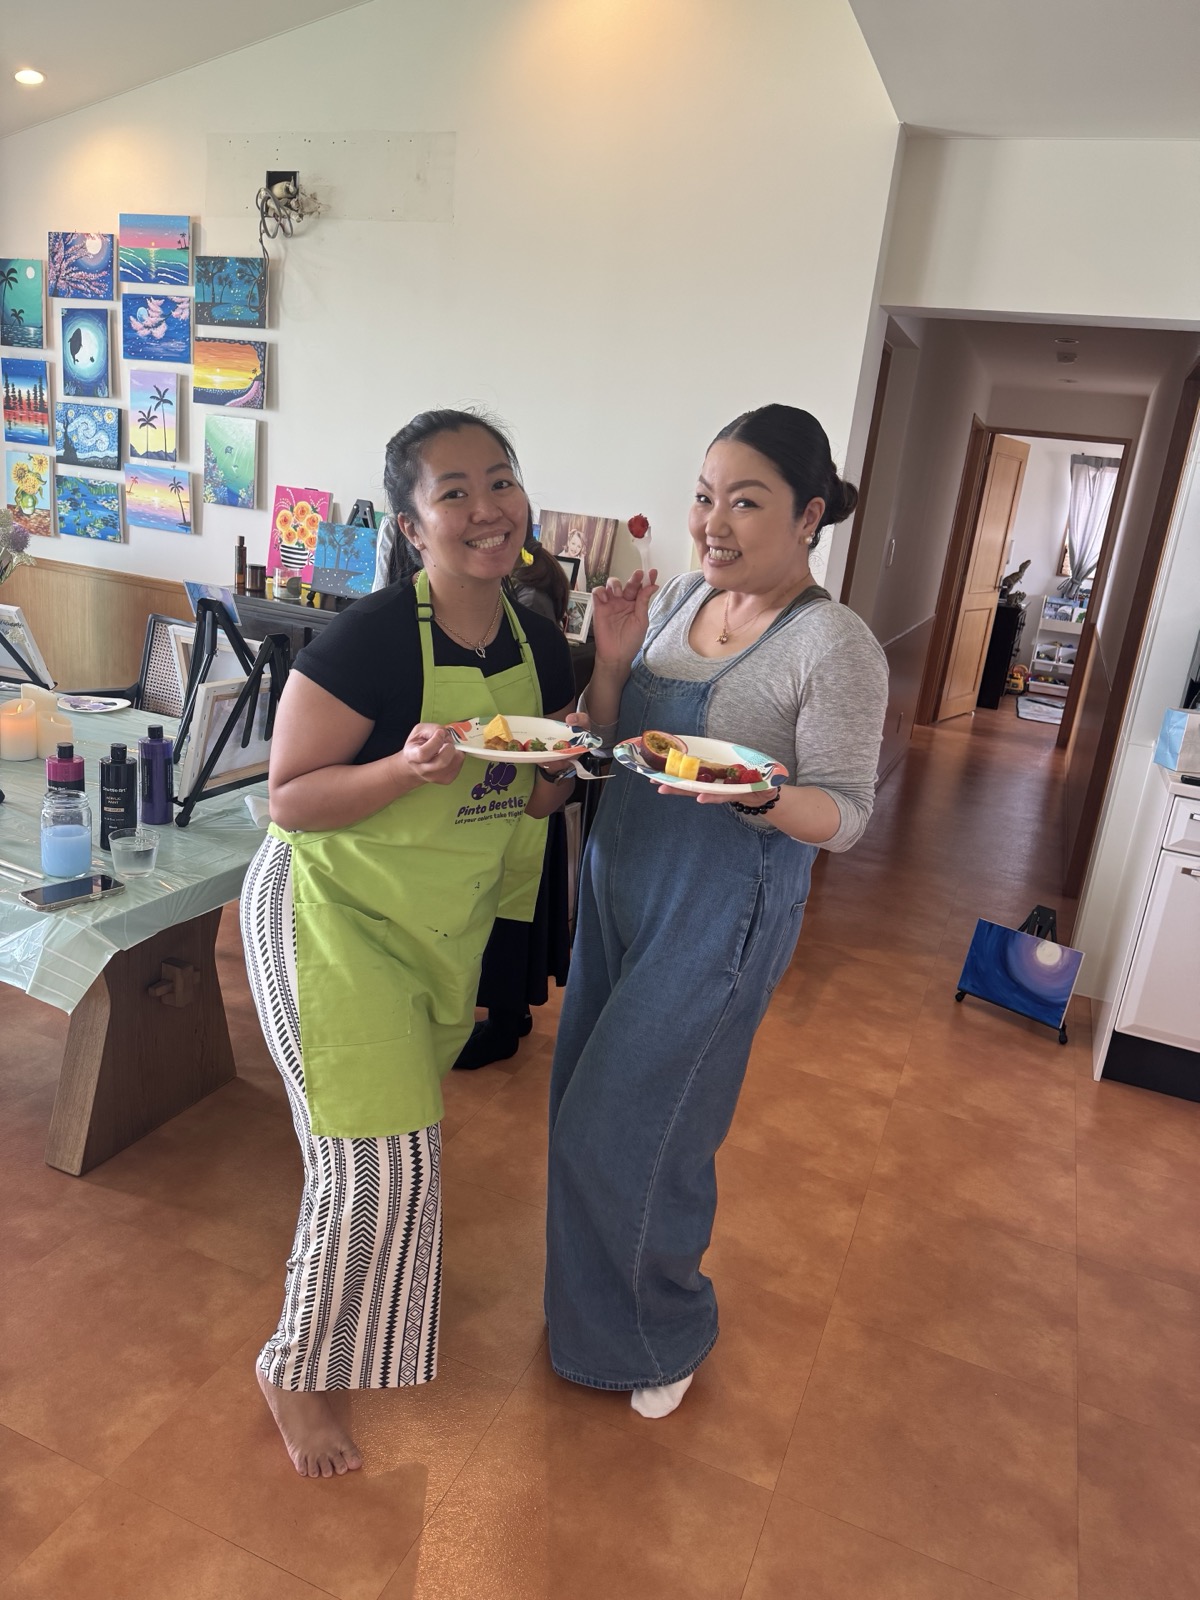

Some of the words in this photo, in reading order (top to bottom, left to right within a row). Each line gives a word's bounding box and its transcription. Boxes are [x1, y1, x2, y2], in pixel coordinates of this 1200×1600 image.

[457, 804, 487, 818] Pinto
[463, 817, 477, 825] your
[477, 814, 493, 822] colors
[493, 811, 507, 819] take
